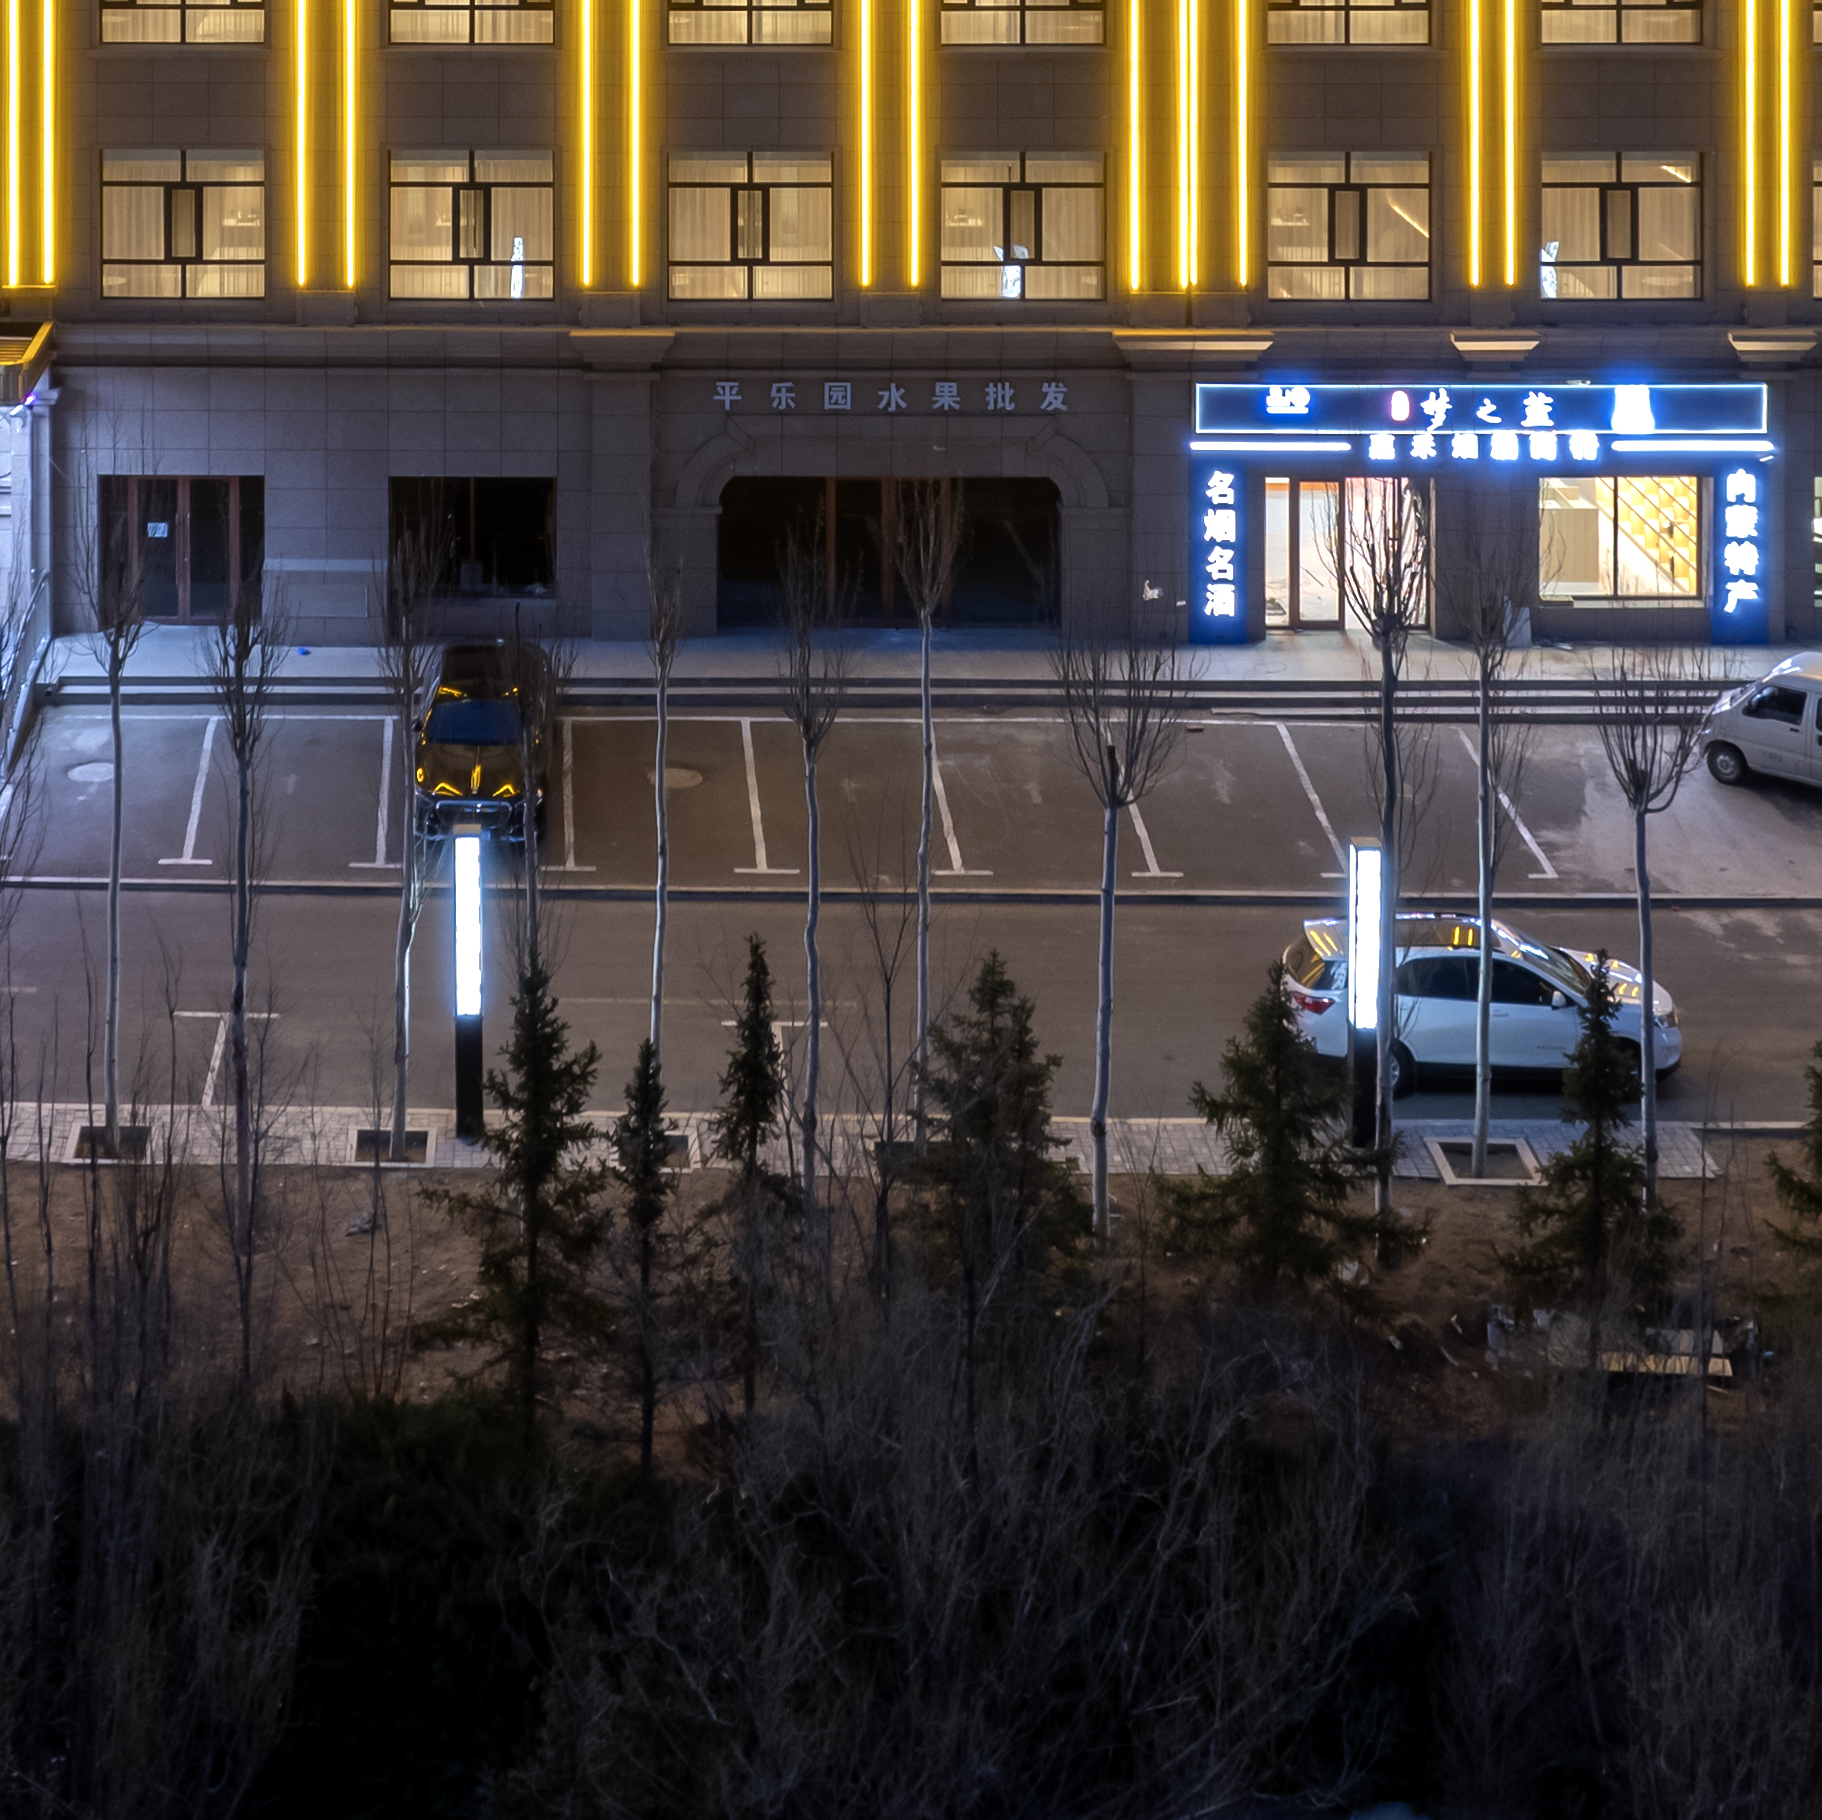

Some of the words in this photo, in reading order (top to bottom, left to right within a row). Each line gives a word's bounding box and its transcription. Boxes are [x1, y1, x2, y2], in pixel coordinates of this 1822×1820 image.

[712, 381, 1069, 411] 平乐园水果批发
[1203, 470, 1236, 617] 名烟名酒
